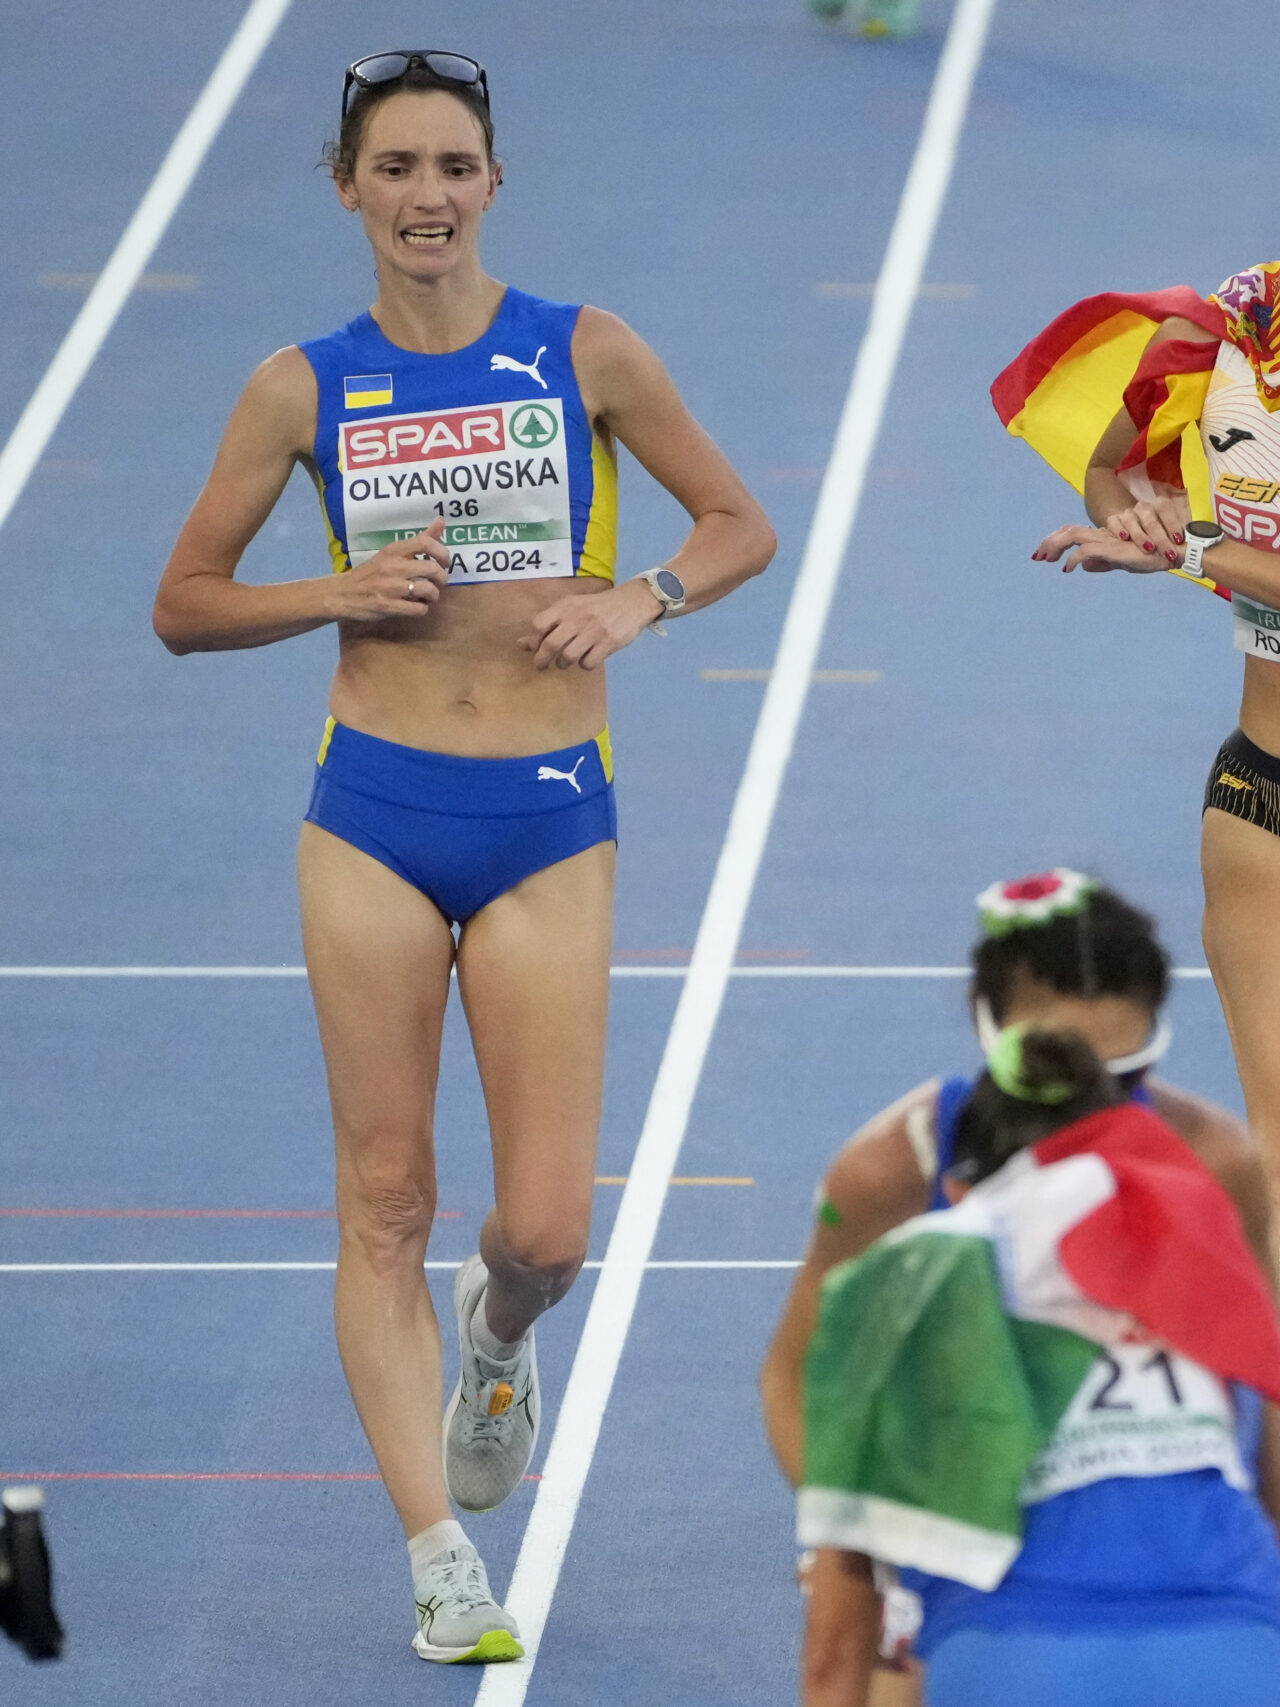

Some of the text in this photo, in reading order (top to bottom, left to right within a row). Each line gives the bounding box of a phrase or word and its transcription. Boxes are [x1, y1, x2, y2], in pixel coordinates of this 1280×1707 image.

[349, 415, 501, 463] SPAR
[349, 457, 560, 501] OLYANOVSKA
[433, 498, 479, 518] 136
[475, 549, 542, 573] 2024
[1090, 1349, 1182, 1412] 21
